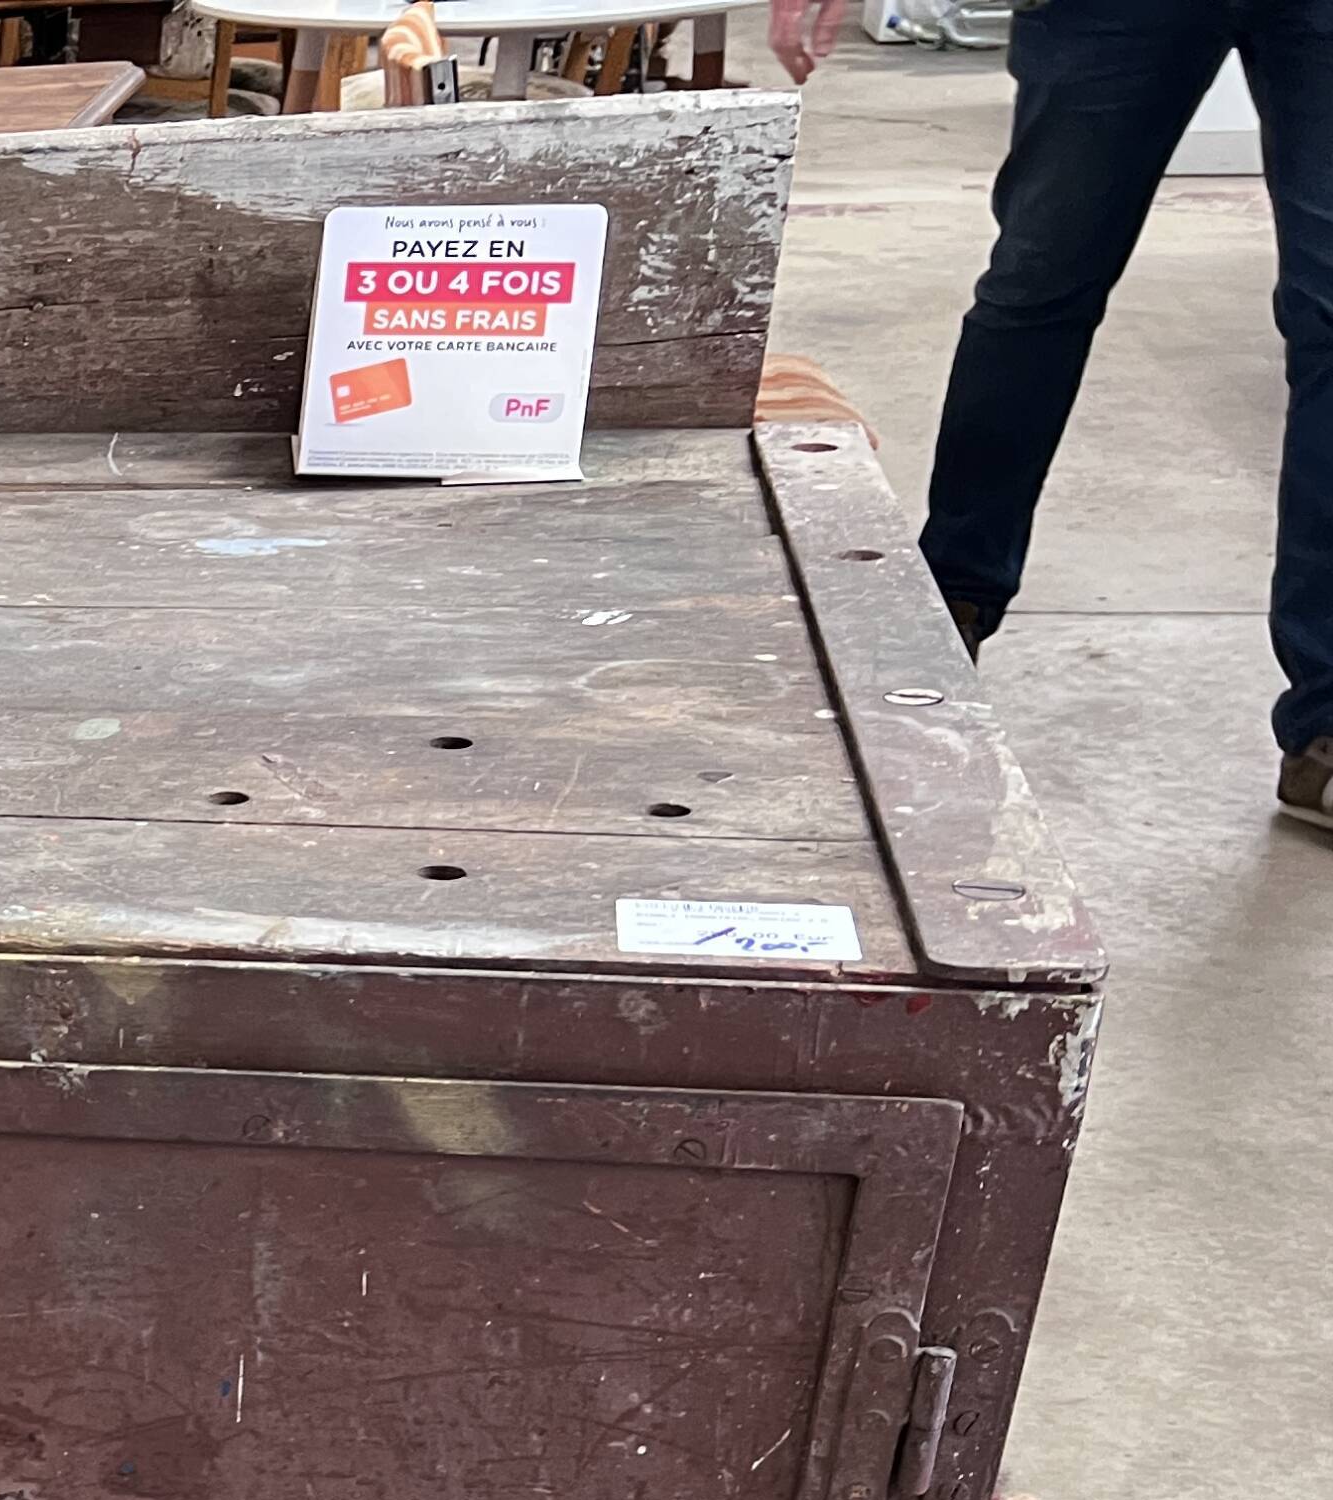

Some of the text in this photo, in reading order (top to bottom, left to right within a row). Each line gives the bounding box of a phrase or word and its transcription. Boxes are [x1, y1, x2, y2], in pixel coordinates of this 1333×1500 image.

[385, 215, 414, 229] Nous
[459, 213, 493, 232] pensé
[392, 240, 525, 257] PAYEZ EN
[357, 270, 562, 295] 3 OU 4 FOIS
[373, 309, 537, 331] SANS FRAIS
[347, 340, 558, 352] AVEC VOTRE CARTE BANCAIRE
[505, 398, 550, 417] PnF
